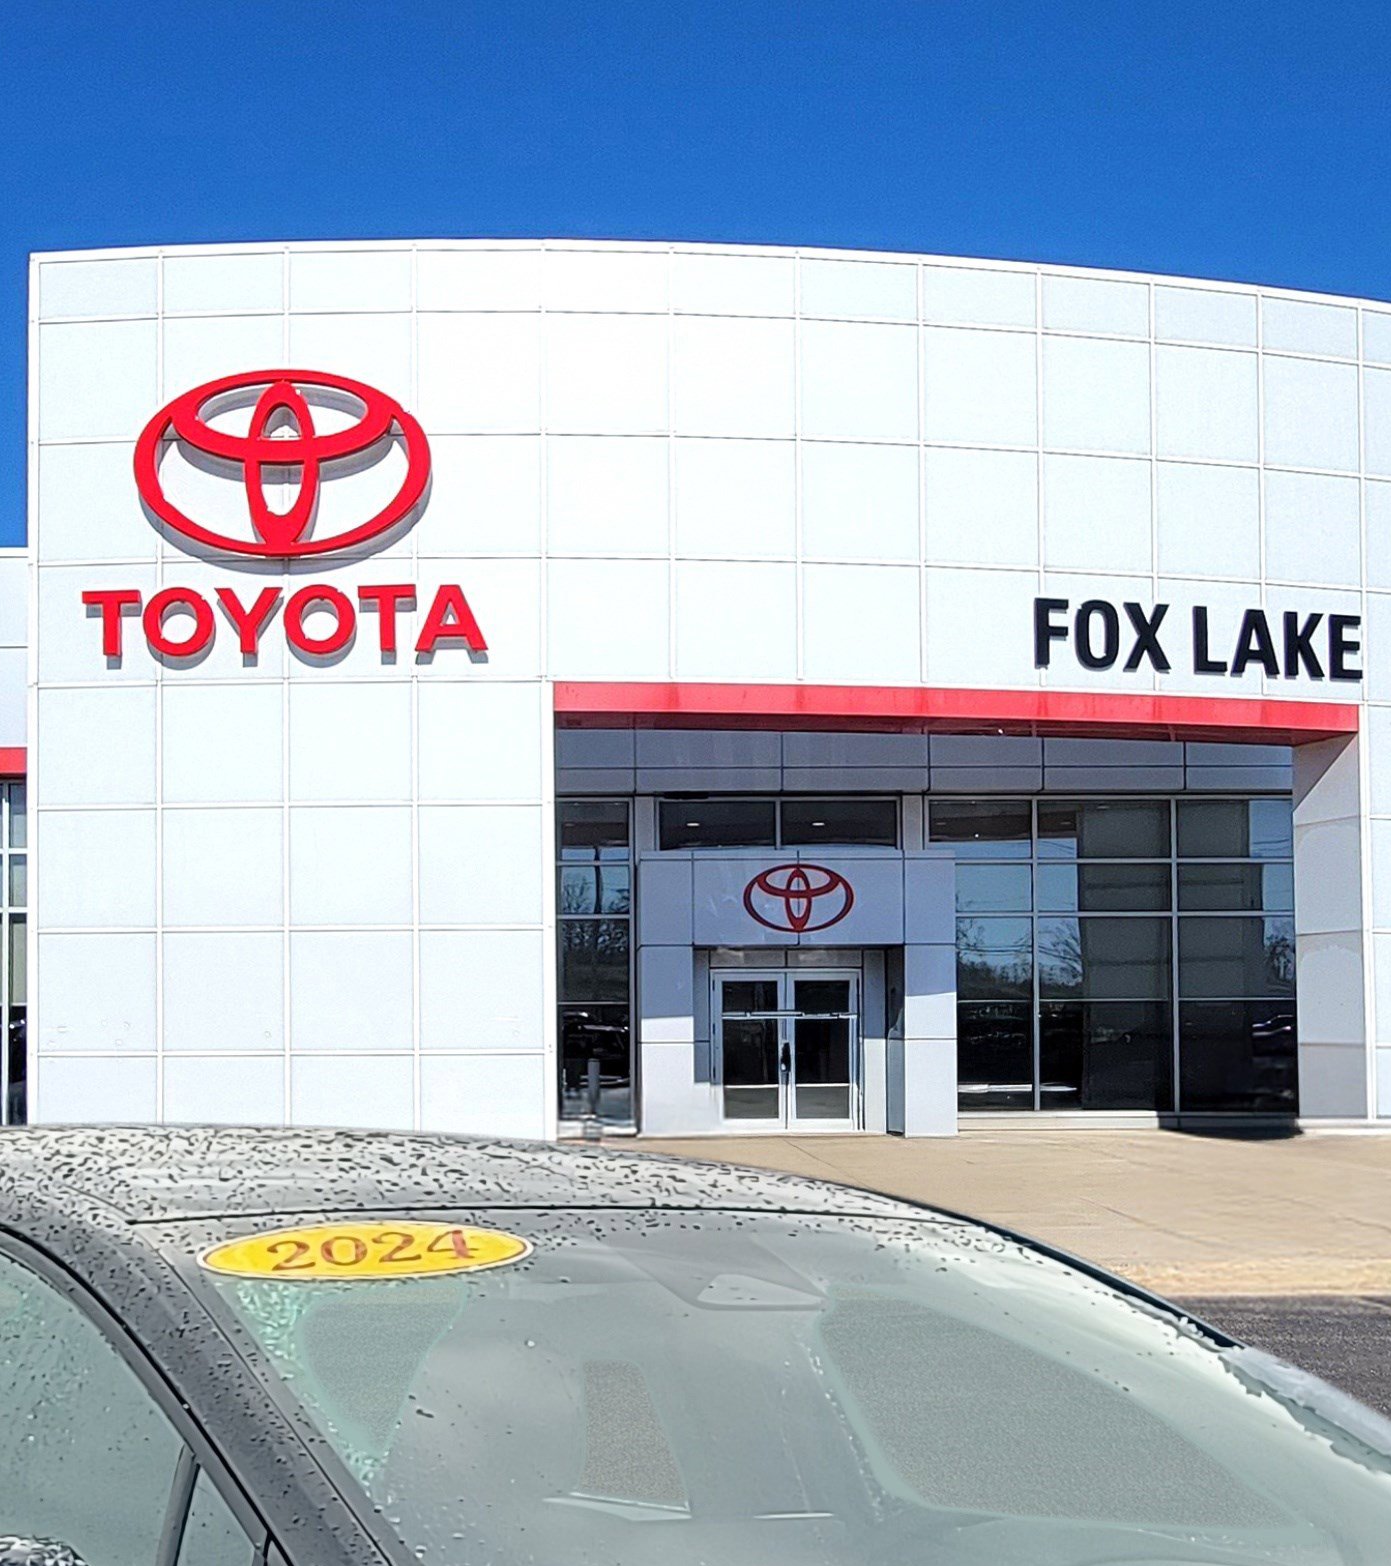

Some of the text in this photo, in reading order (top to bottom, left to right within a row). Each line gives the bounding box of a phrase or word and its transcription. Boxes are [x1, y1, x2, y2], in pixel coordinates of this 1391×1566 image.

[82, 584, 489, 664] TOYOTA
[1034, 597, 1364, 681] FOX LAKE
[266, 1228, 480, 1272] 2024
